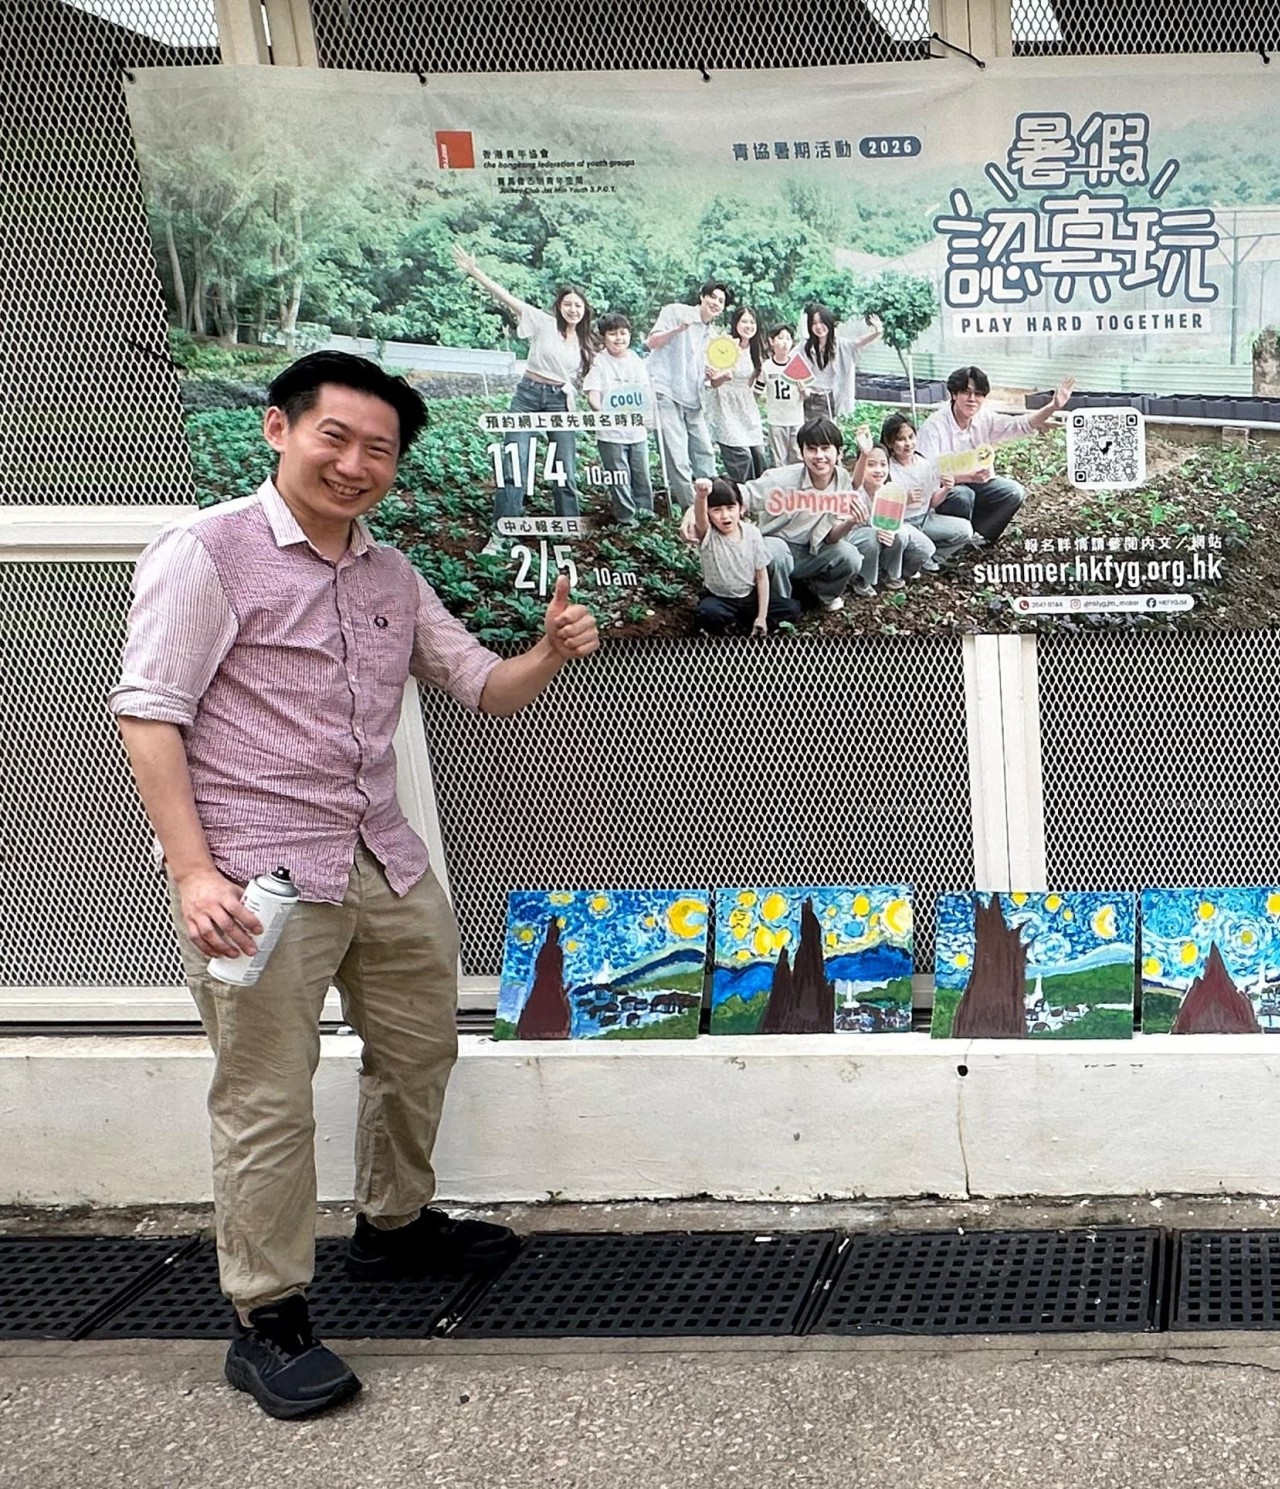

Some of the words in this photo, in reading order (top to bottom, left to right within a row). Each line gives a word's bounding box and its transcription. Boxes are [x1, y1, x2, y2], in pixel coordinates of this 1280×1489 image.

[483, 148, 549, 160] 香港青年協會
[732, 139, 853, 161] 青協暑期活動
[868, 138, 913, 156] 2026
[1007, 112, 1149, 189] 暑假
[483, 161, 496, 169] the
[577, 159, 585, 168] of
[587, 159, 607, 169] youth
[609, 159, 635, 169] groups
[933, 189, 1220, 308] 認真玩
[961, 317, 1012, 333] PLAY
[1027, 315, 1082, 332] HARD
[1095, 313, 1203, 331] TOGETHER
[485, 414, 644, 430] 預約網上優先報名時段
[487, 437, 568, 496] 11/4
[584, 465, 629, 486] 10am
[504, 519, 579, 533] 中心報名日
[511, 540, 578, 597] 2/5
[593, 567, 638, 587] 10am
[974, 553, 1223, 588] summer.hkfyg.org.hk
